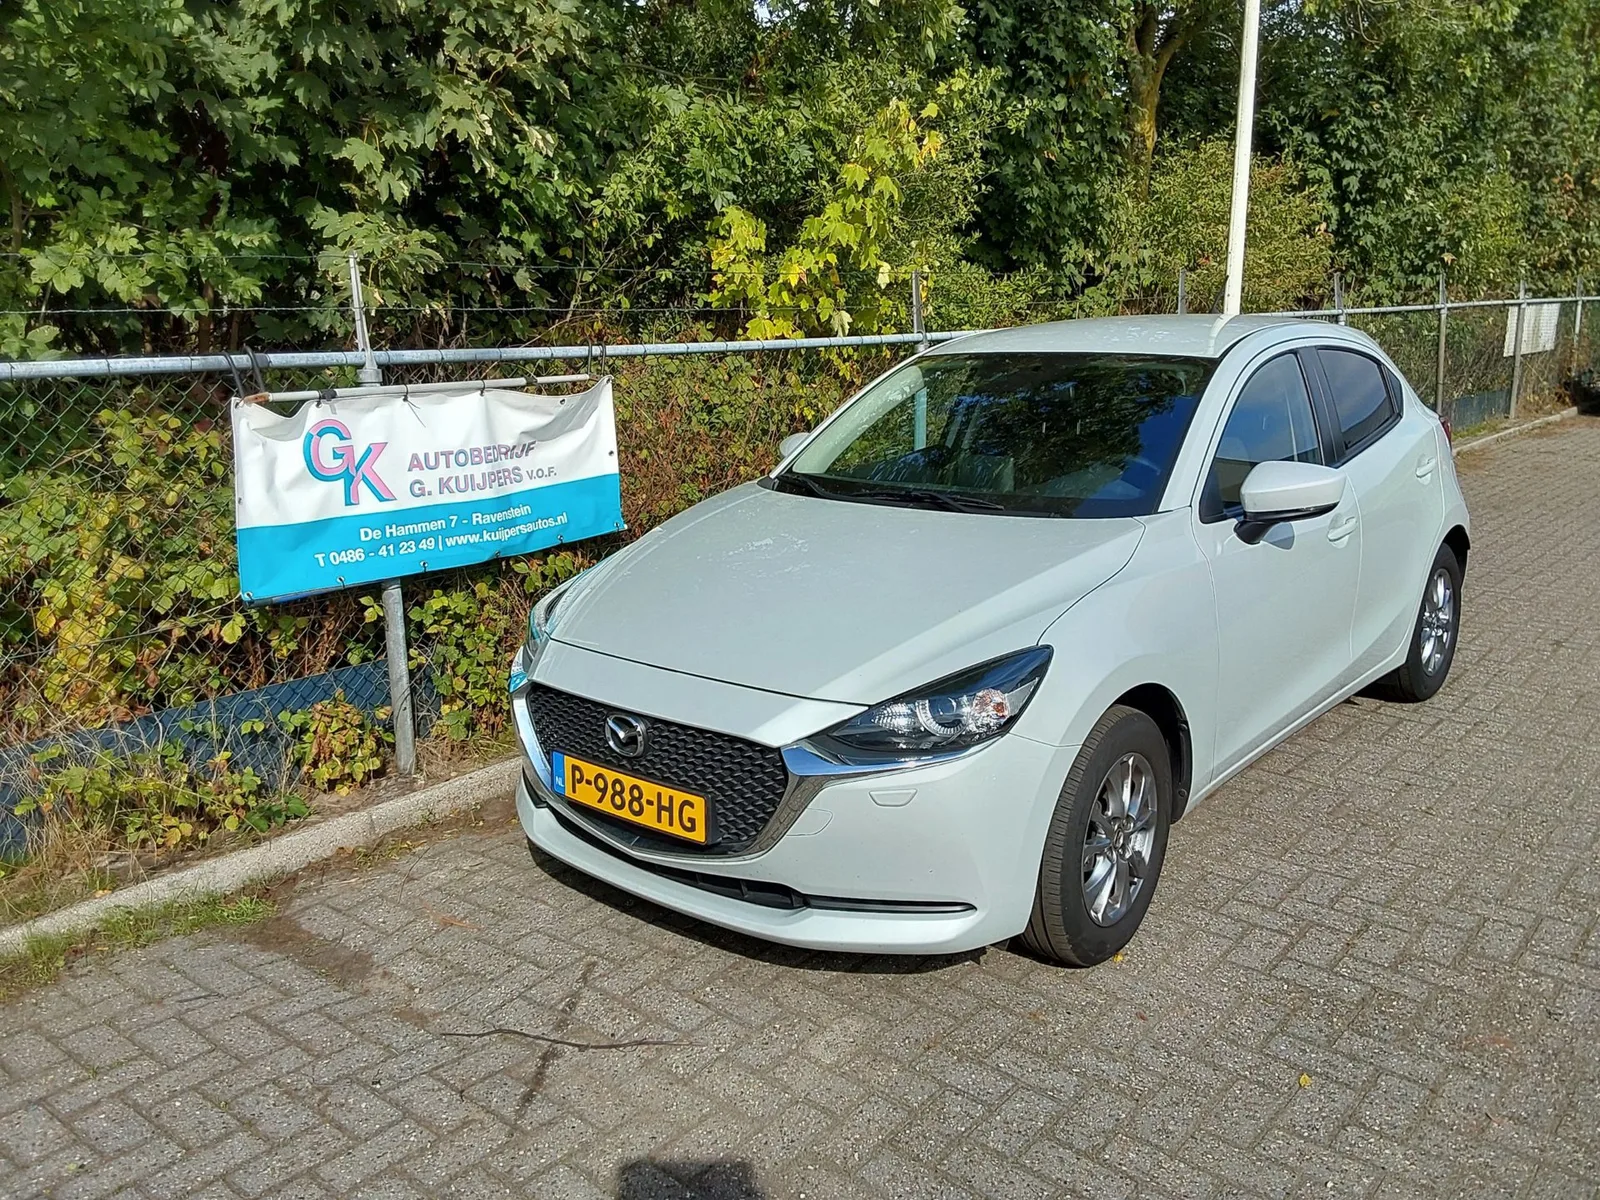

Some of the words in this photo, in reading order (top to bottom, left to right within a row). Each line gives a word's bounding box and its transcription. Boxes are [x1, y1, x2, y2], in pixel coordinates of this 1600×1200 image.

[303, 419, 398, 506] GK
[407, 440, 537, 472] AUTOBEDRIJF
[409, 478, 433, 498] G.
[438, 465, 524, 495] KUIJPERS
[525, 466, 557, 481] V.O.F.
[314, 553, 325, 567] T
[329, 548, 365, 565] 0486
[378, 543, 395, 557] 41
[399, 540, 416, 555] 23
[418, 537, 435, 550] 49
[445, 512, 568, 548] www.kuijpersautos.nl
[359, 527, 382, 541] De
[385, 519, 446, 538] Hammen
[449, 515, 458, 528] 7
[472, 504, 532, 526] Ravenstein
[555, 775, 565, 788] NL
[571, 763, 697, 834] P-988-HG
